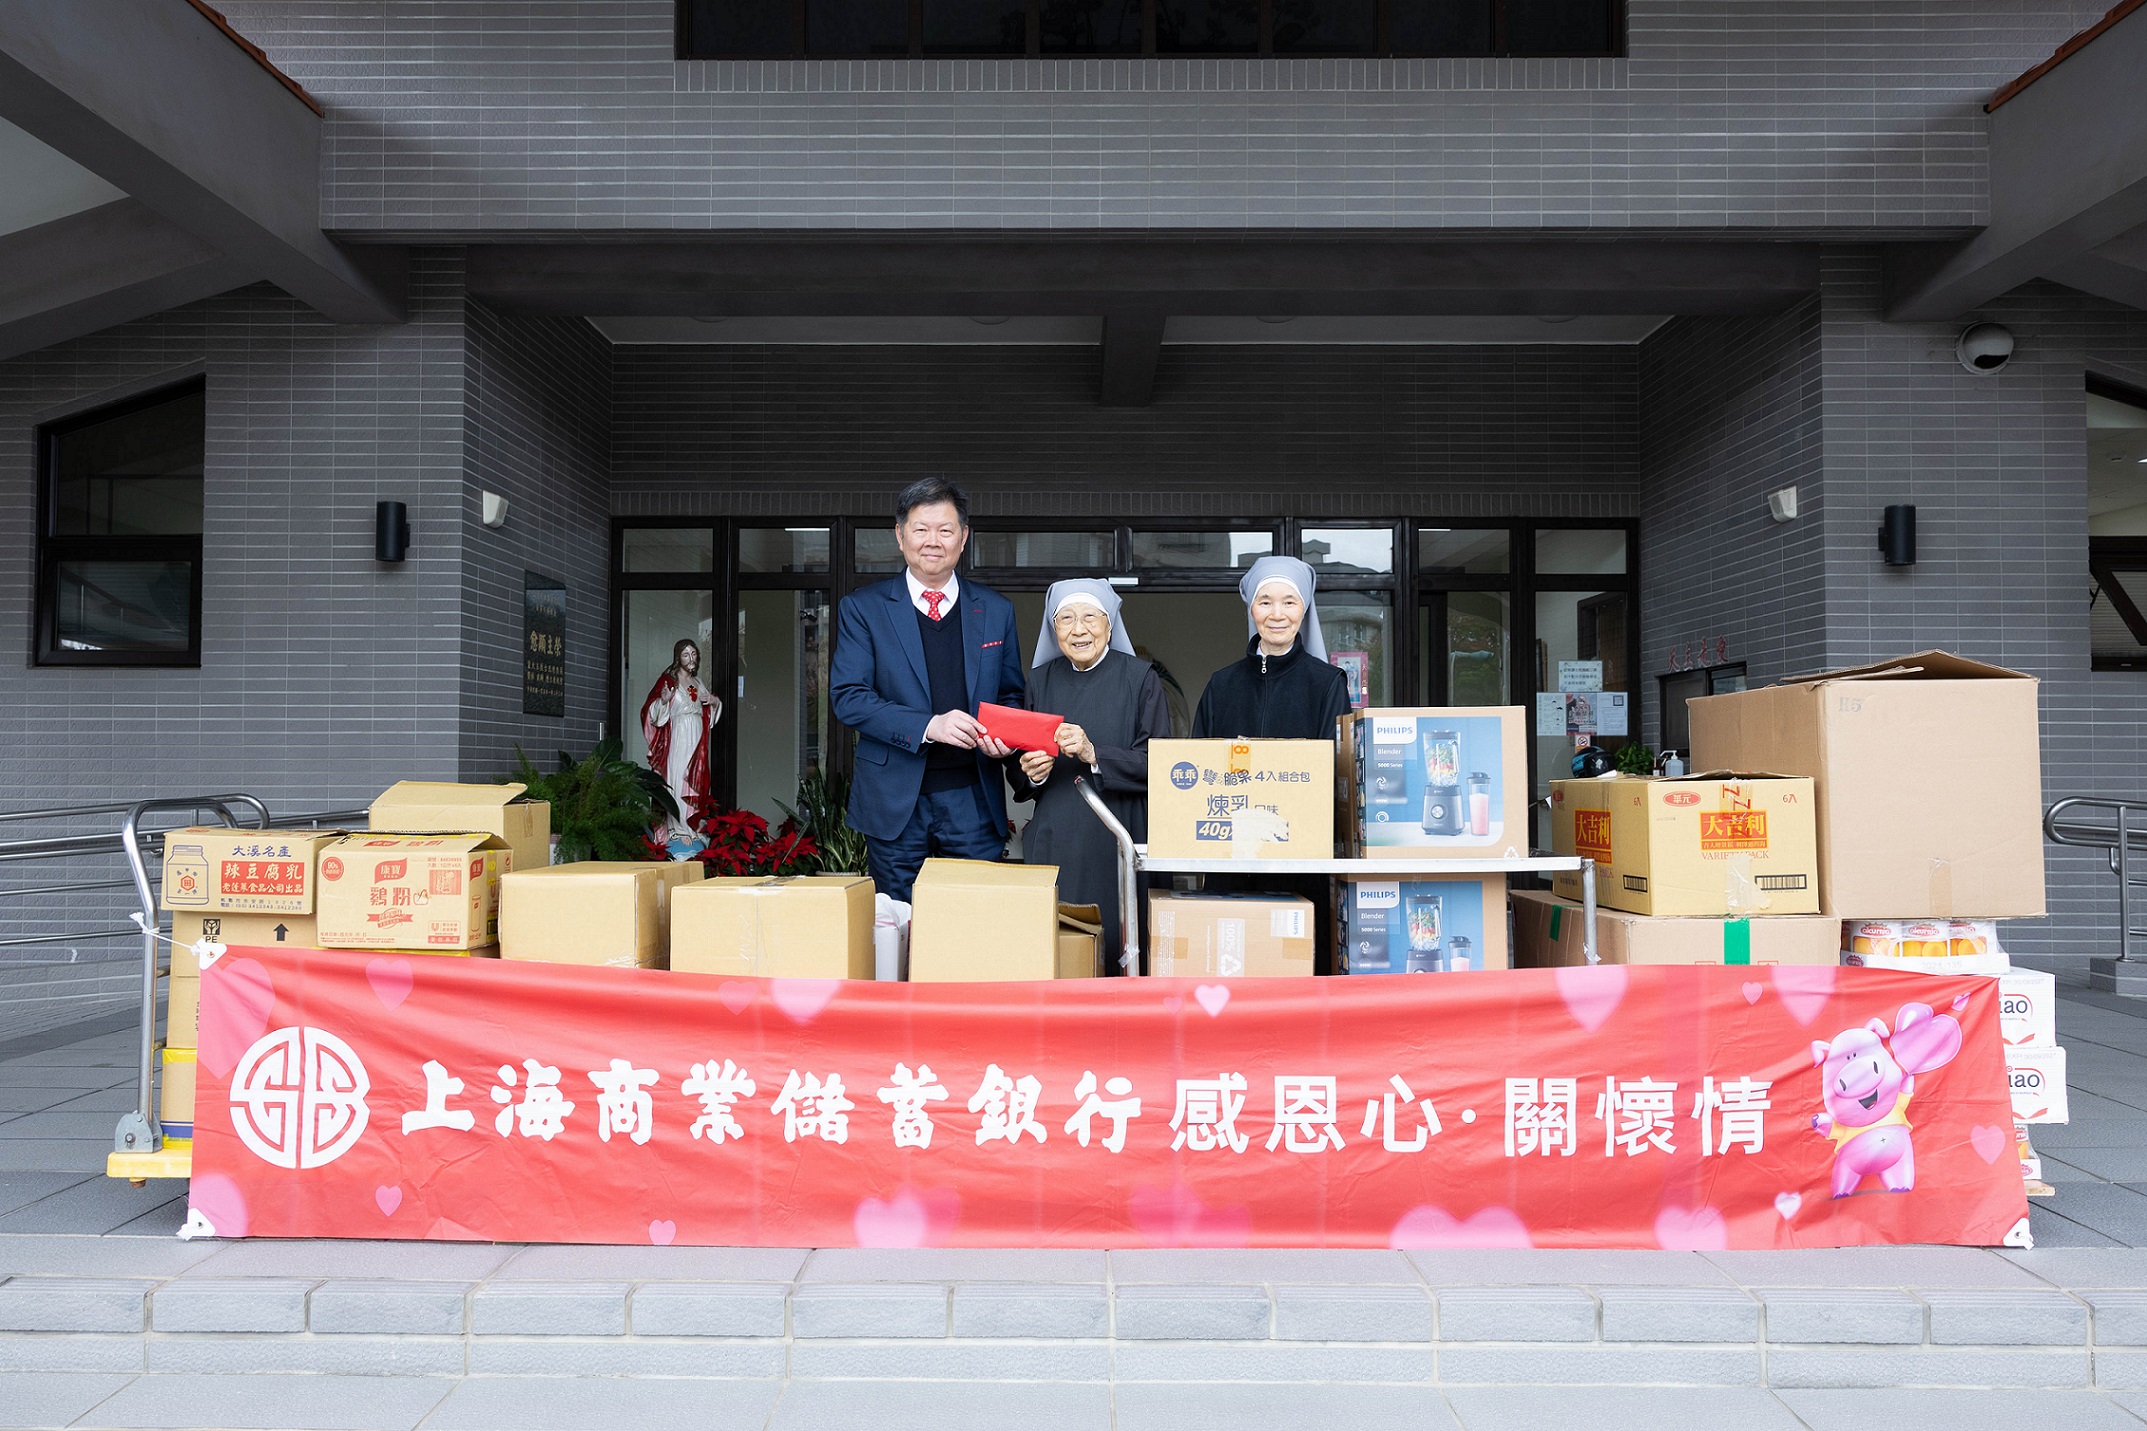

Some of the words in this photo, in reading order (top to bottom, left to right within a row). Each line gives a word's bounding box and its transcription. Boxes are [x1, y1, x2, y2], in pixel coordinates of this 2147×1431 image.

[1839, 697, 1861, 712] H5
[1172, 768, 1197, 782] 乖乖
[1255, 770, 1311, 783] 4入組合包
[1207, 794, 1249, 817] 煉乳
[1672, 794, 1692, 804] 華元
[1782, 793, 1798, 804] 6入
[1198, 822, 1233, 840] 40g
[1576, 814, 1610, 846] 大吉利
[1703, 813, 1765, 837] 大吉利
[232, 845, 292, 858] 大溪名產
[1701, 851, 1744, 860] VARIE
[224, 862, 303, 880] 辣豆腐乳
[380, 864, 401, 875] 康寶
[1360, 891, 1396, 899] PHILIPS
[1225, 922, 1235, 951] 100%
[2008, 1074, 2040, 1088] iao
[400, 1057, 1142, 1154] 上海商業儲蓄銀行
